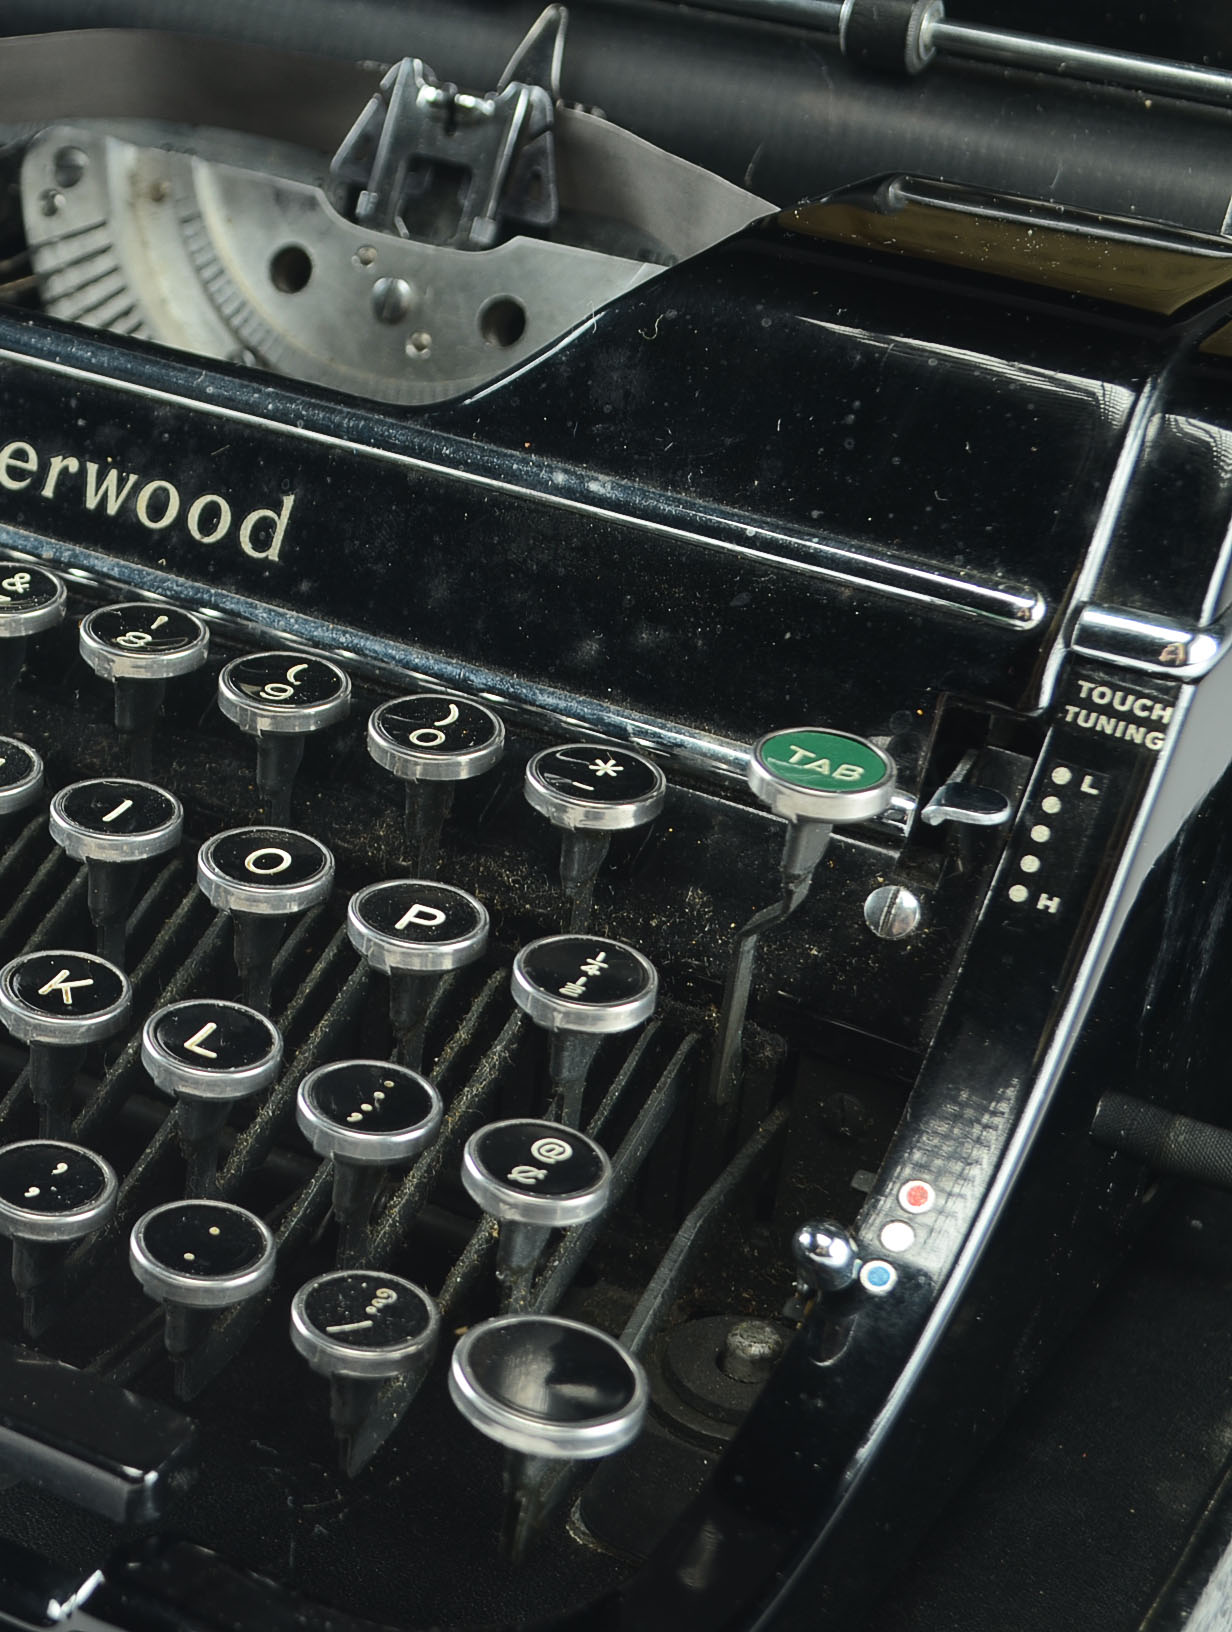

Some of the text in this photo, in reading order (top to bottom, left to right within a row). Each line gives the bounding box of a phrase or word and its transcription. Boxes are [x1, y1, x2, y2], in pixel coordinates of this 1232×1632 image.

[1077, 679, 1175, 724] TOUCH
[1064, 704, 1166, 751] TUNING
[788, 744, 865, 781] TAB
[1080, 775, 1099, 795] L
[244, 847, 292, 875] O
[394, 903, 446, 930] P
[1036, 893, 1061, 914] H
[38, 969, 94, 1005] K
[183, 1022, 218, 1058] L
